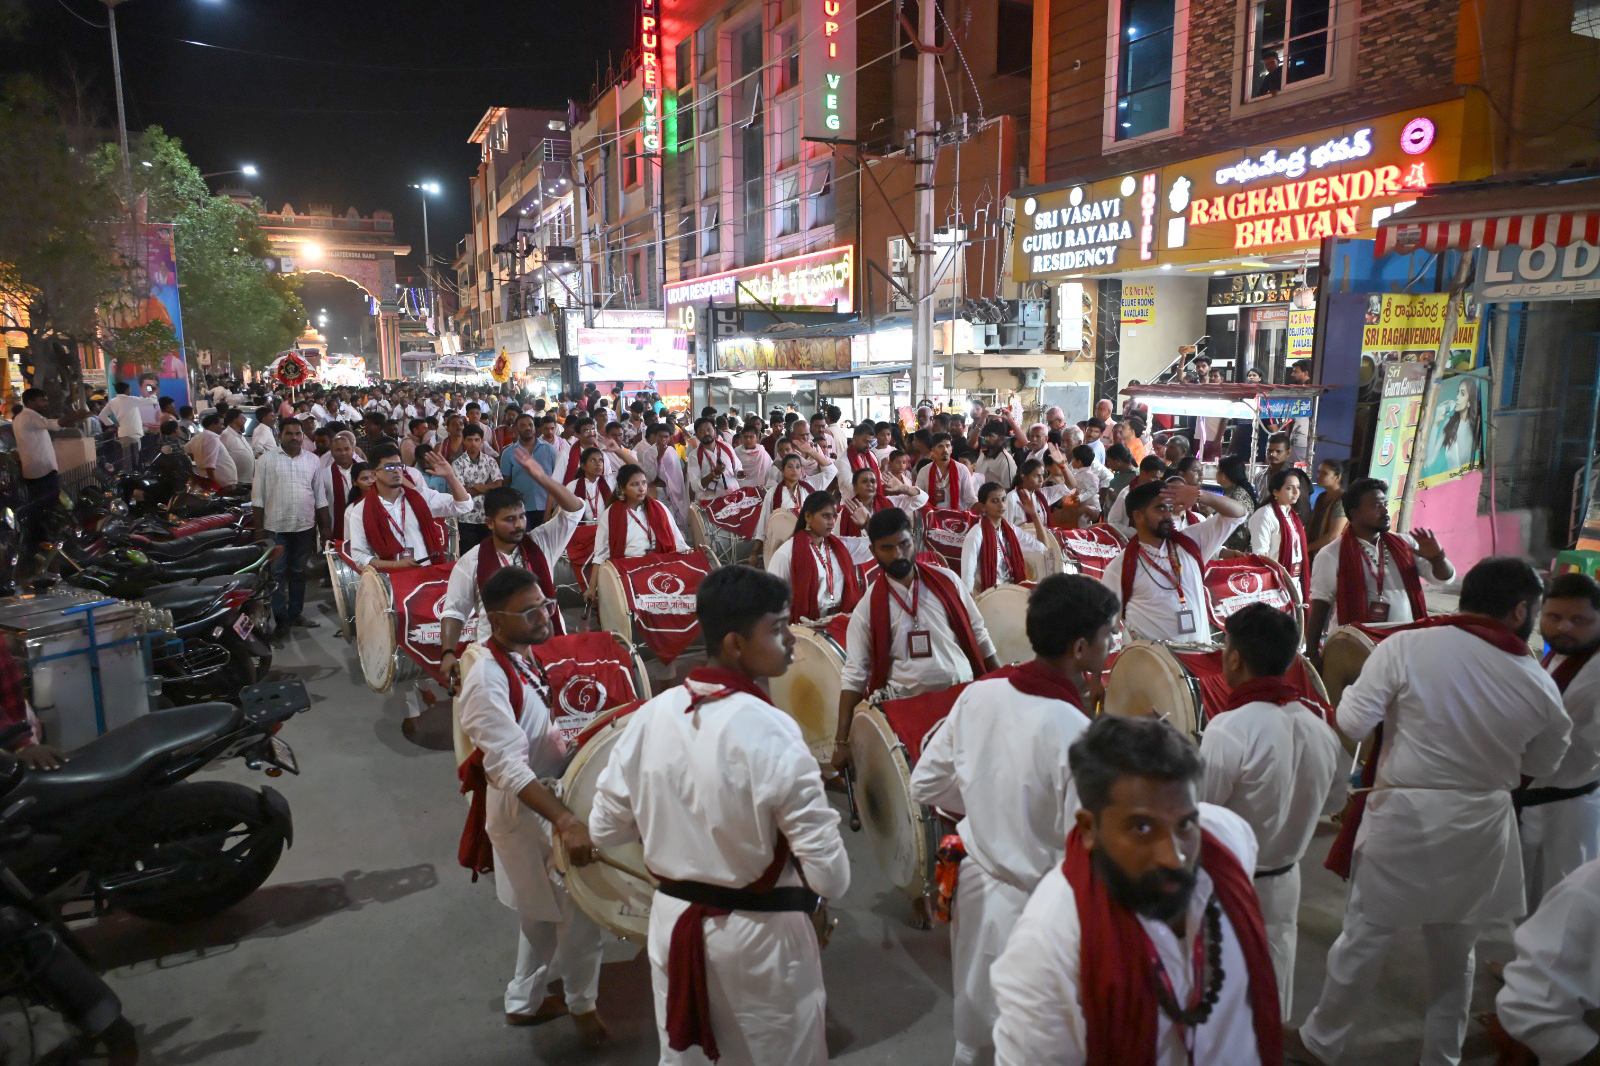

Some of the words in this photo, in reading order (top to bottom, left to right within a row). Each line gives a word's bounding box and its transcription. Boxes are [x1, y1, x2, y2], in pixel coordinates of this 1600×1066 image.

[642, 16, 657, 85] PURE
[825, 73, 840, 130] VEG
[643, 96, 659, 149] VEG
[1190, 162, 1427, 225] RAGHAVENDRA
[1035, 210, 1058, 230] SRI
[1060, 198, 1121, 226] VASAVI
[1140, 173, 1156, 261] HOTEL
[1234, 206, 1361, 250] BHAVAN
[1022, 231, 1062, 253] GURU
[1064, 220, 1132, 248] RAYARA
[1033, 245, 1118, 273] RESIDENCY
[667, 285, 689, 304] UDUPI
[690, 276, 735, 301] RESIDENCY
[1121, 298, 1137, 307] ELUXE
[1138, 298, 1155, 307] ROOMS
[1503, 285, 1541, 297] A/C
[1123, 308, 1149, 318] AVAILABLE
[1383, 296, 1393, 323] శ్రీ
[1364, 327, 1380, 346] SRI
[1381, 326, 1441, 345] RAGHAVENDRA
[1452, 326, 1475, 344] AVAN
[1387, 365, 1402, 378] Sri
